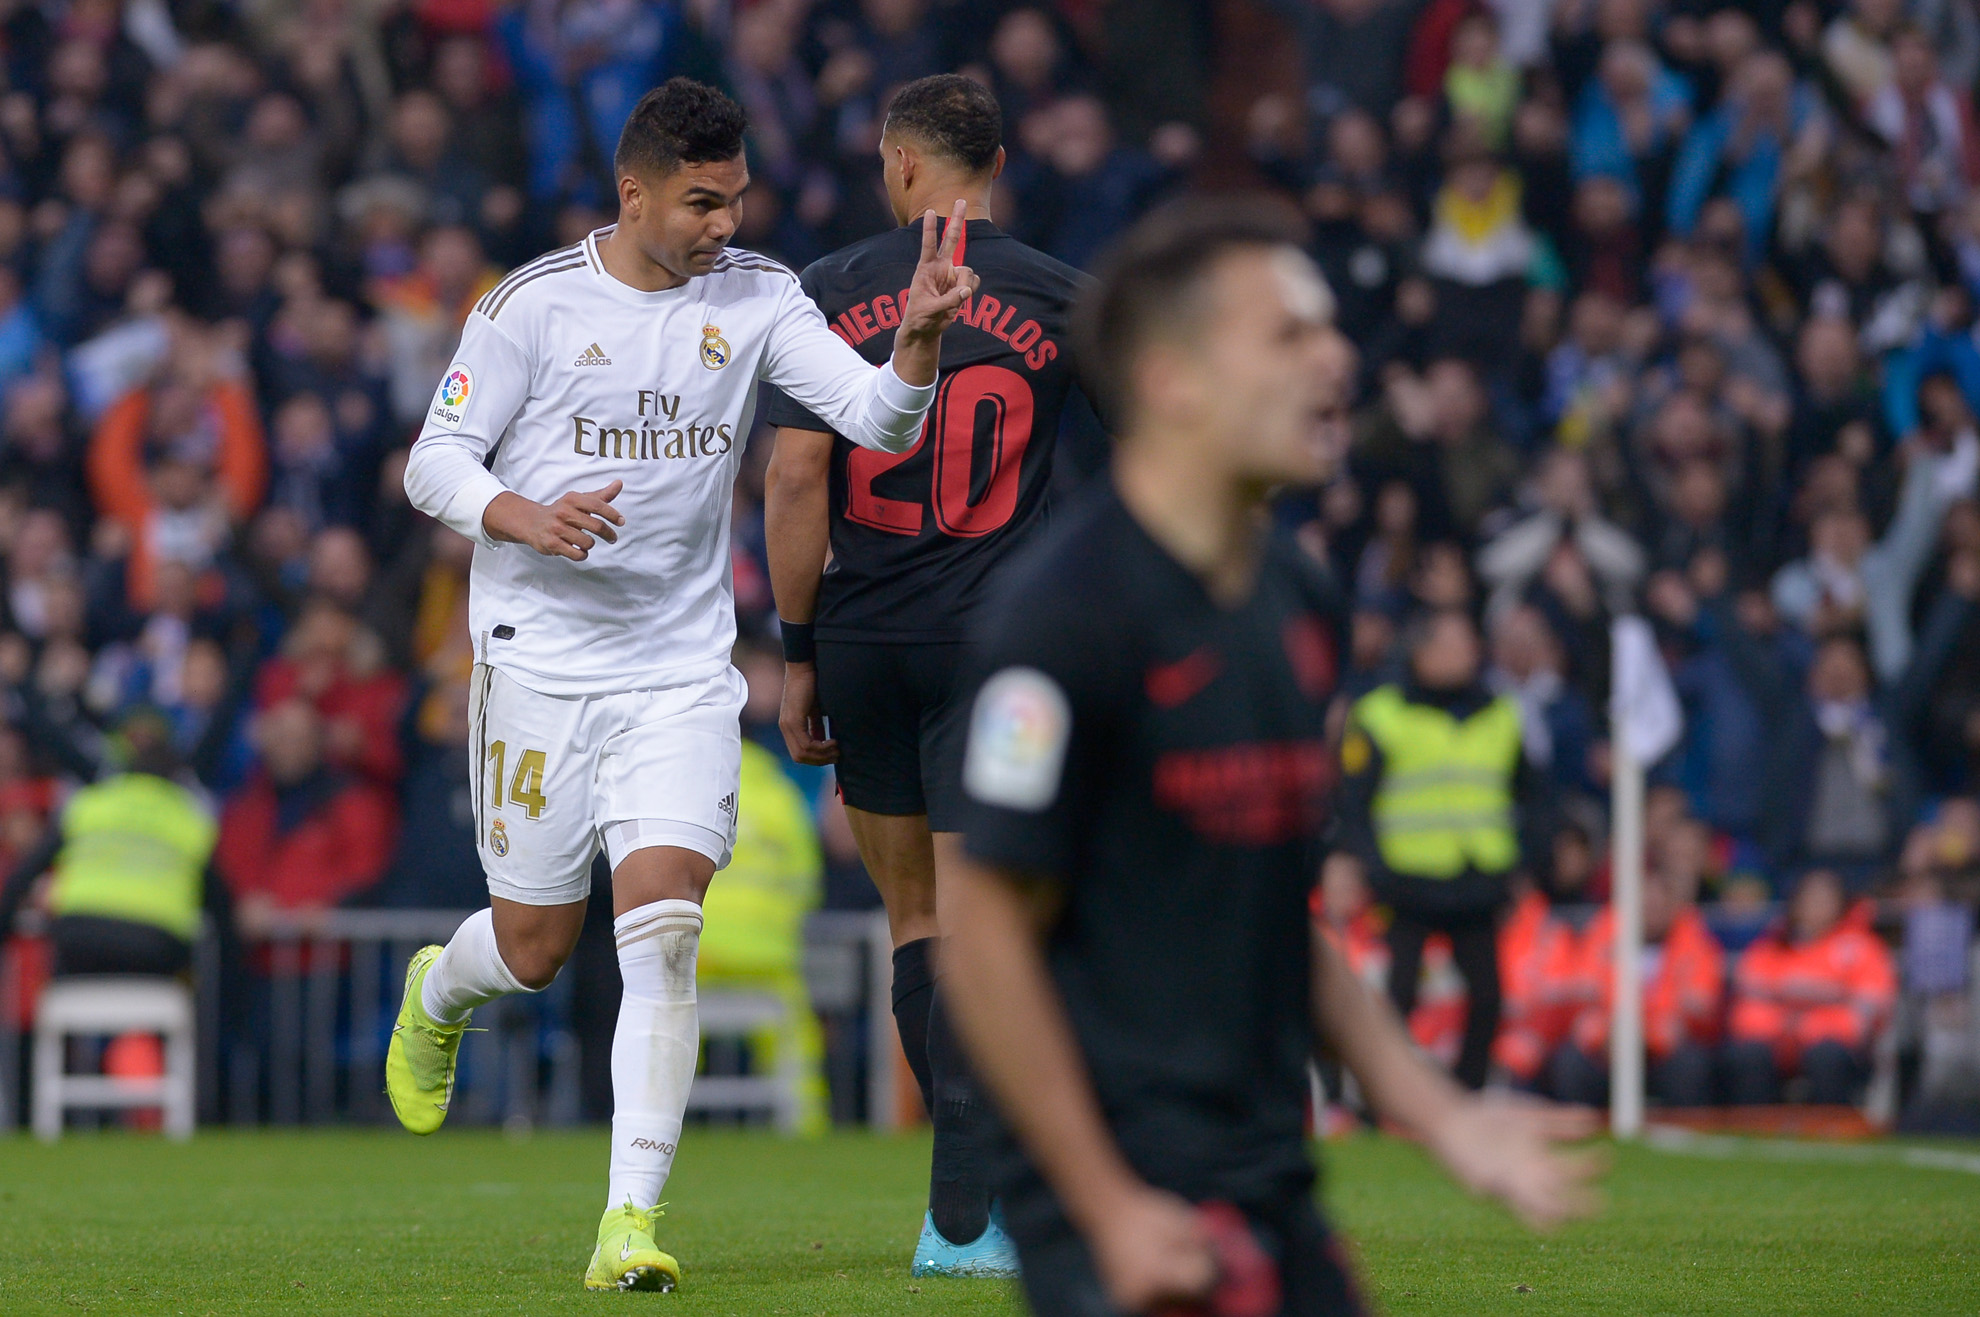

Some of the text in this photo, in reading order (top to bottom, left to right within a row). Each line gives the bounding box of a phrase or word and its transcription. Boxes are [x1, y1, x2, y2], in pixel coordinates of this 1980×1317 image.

[952, 294, 1058, 371] ARLOS
[574, 357, 612, 367] adidas
[434, 406, 460, 423] LaLiga
[638, 390, 680, 421] Fly
[573, 416, 732, 460] Emirates
[844, 365, 1034, 537] 20
[488, 740, 546, 821] 14
